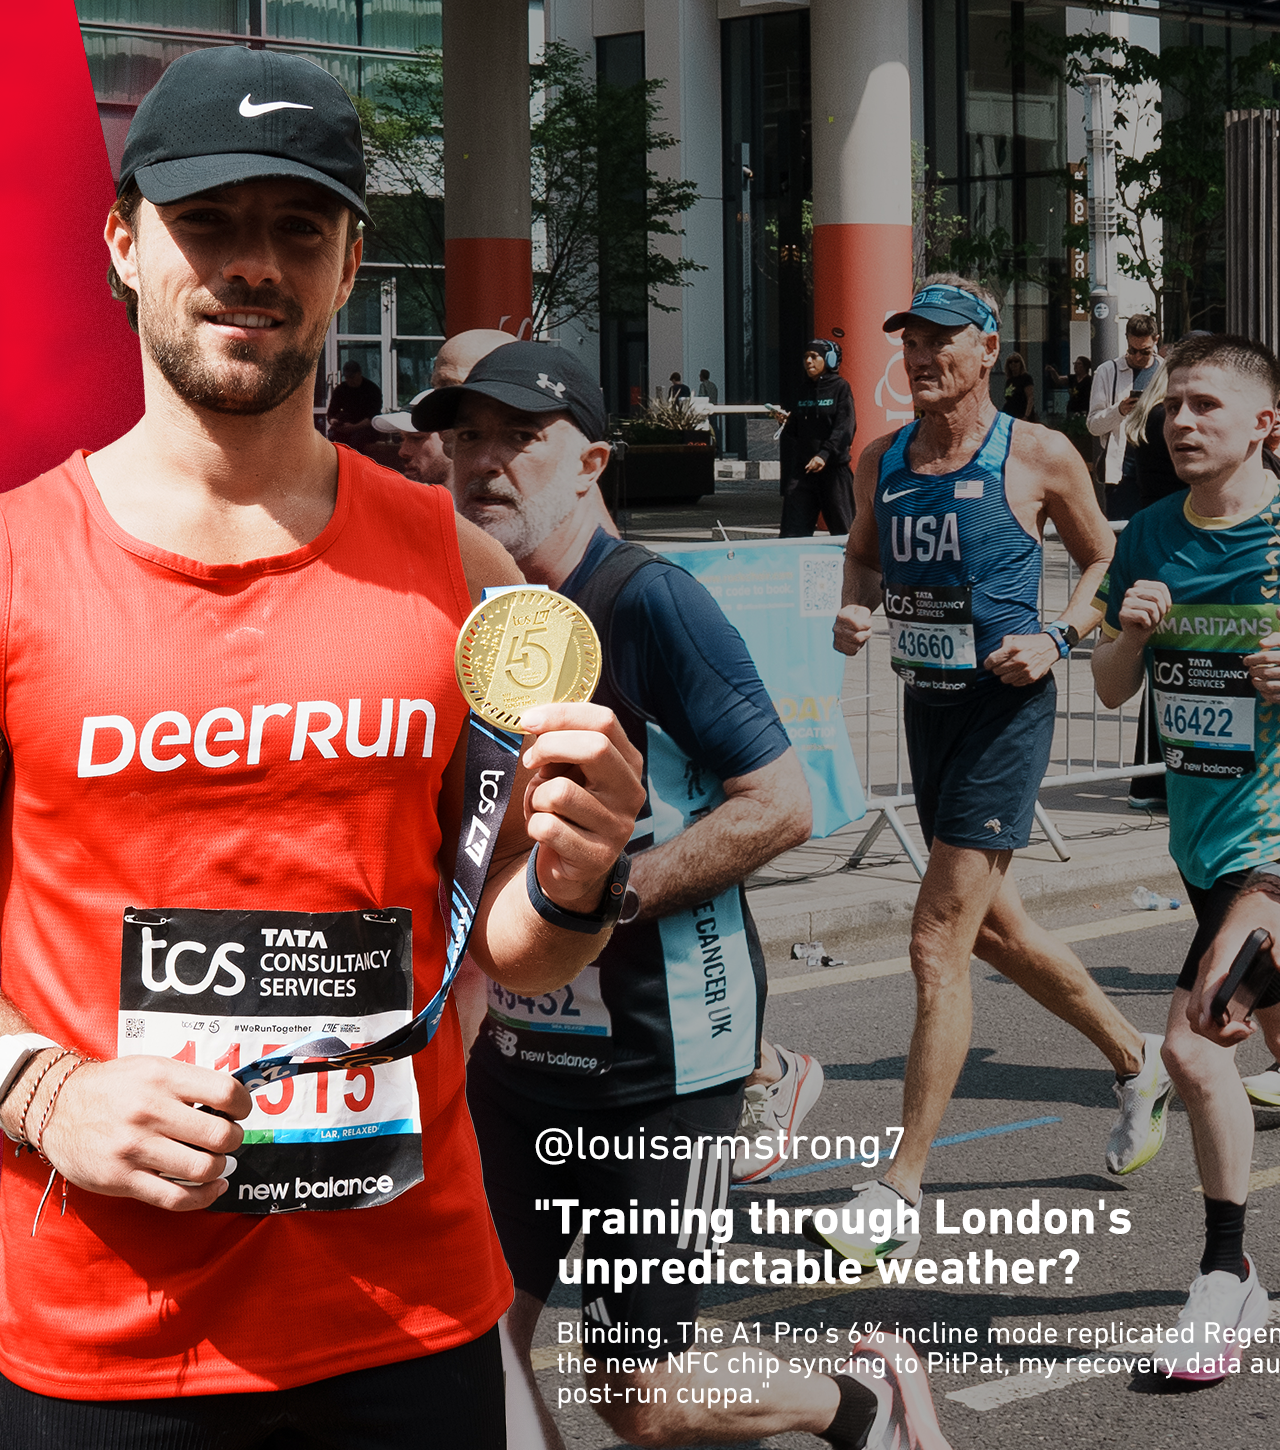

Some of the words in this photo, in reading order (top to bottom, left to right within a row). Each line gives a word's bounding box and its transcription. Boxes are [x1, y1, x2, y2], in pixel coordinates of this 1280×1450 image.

[891, 512, 962, 562] USA
[726, 585, 751, 597] code
[753, 585, 764, 596] to
[766, 583, 794, 595] book.
[915, 591, 933, 599] TATA
[886, 588, 914, 615] tcs
[916, 600, 965, 610] CONSULTANCY
[916, 609, 945, 618] SERVICES
[898, 630, 954, 659] 43660
[1153, 655, 1184, 686] tcs
[1187, 657, 1213, 668] TATA
[1187, 668, 1250, 679] CONSULTANCY
[1187, 679, 1226, 689] SERVICES
[1163, 703, 1233, 738] 46422
[1183, 762, 1202, 772] new
[1202, 762, 1244, 775] balance
[478, 770, 505, 814] tcs
[261, 928, 328, 949] TATA
[141, 926, 245, 996] tcs
[260, 949, 392, 974] CONSULTANCY
[695, 917, 727, 1006] CANCER
[259, 977, 357, 998] SERVICES
[234, 1024, 312, 1035] #WeRunTogether
[707, 1006, 732, 1039] UK
[521, 1050, 545, 1063] new
[546, 1051, 598, 1069] balance
[342, 1126, 378, 1137] RELAXED
[238, 1181, 290, 1200] new
[294, 1174, 394, 1200] balance
